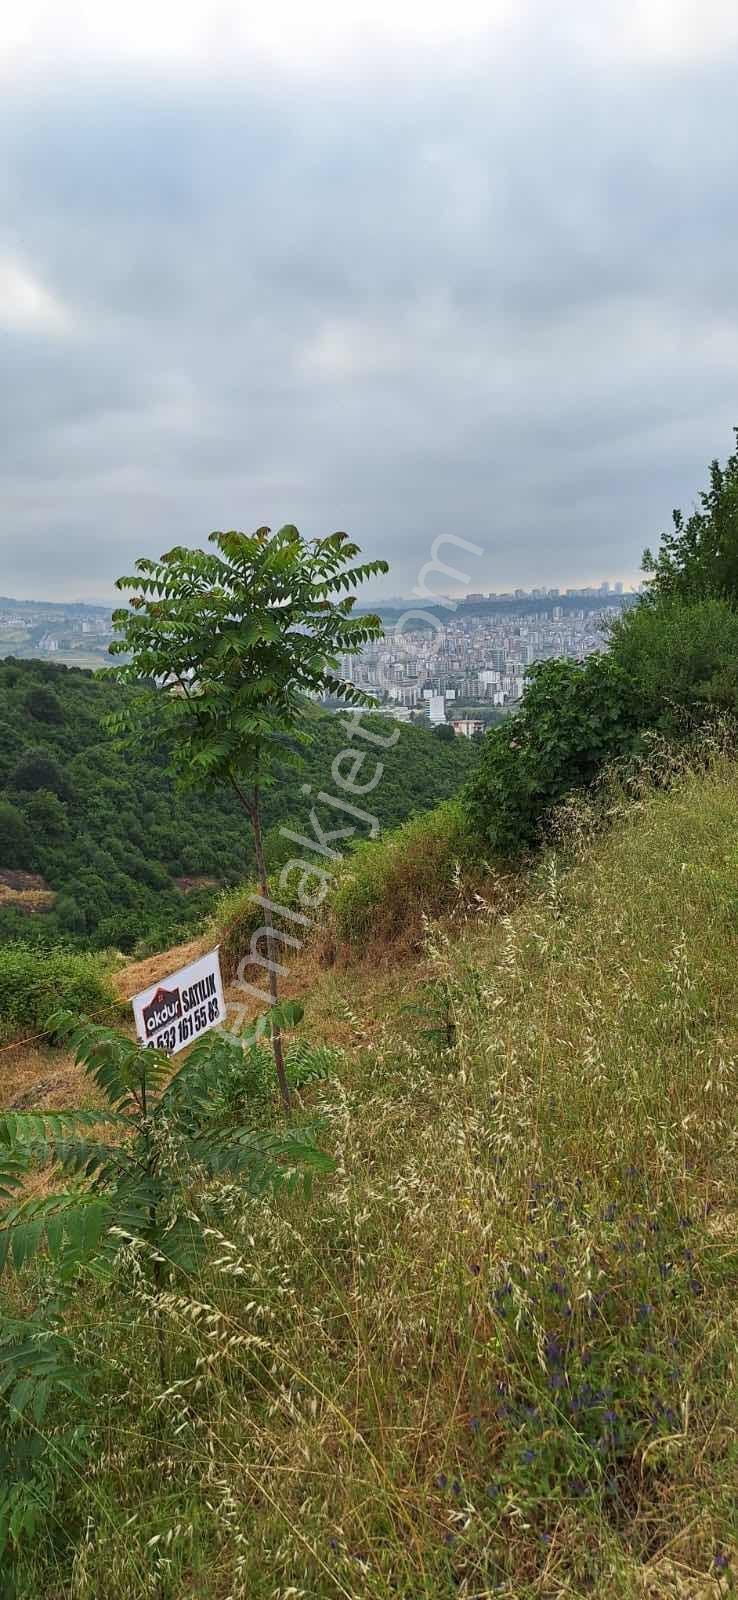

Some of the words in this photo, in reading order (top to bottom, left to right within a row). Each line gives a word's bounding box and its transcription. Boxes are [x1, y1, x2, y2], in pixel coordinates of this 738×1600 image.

[181, 973, 217, 1013] SATILIK
[147, 1001, 179, 1031] akdur
[178, 1014, 194, 1043] 161
[194, 1005, 208, 1032] 55
